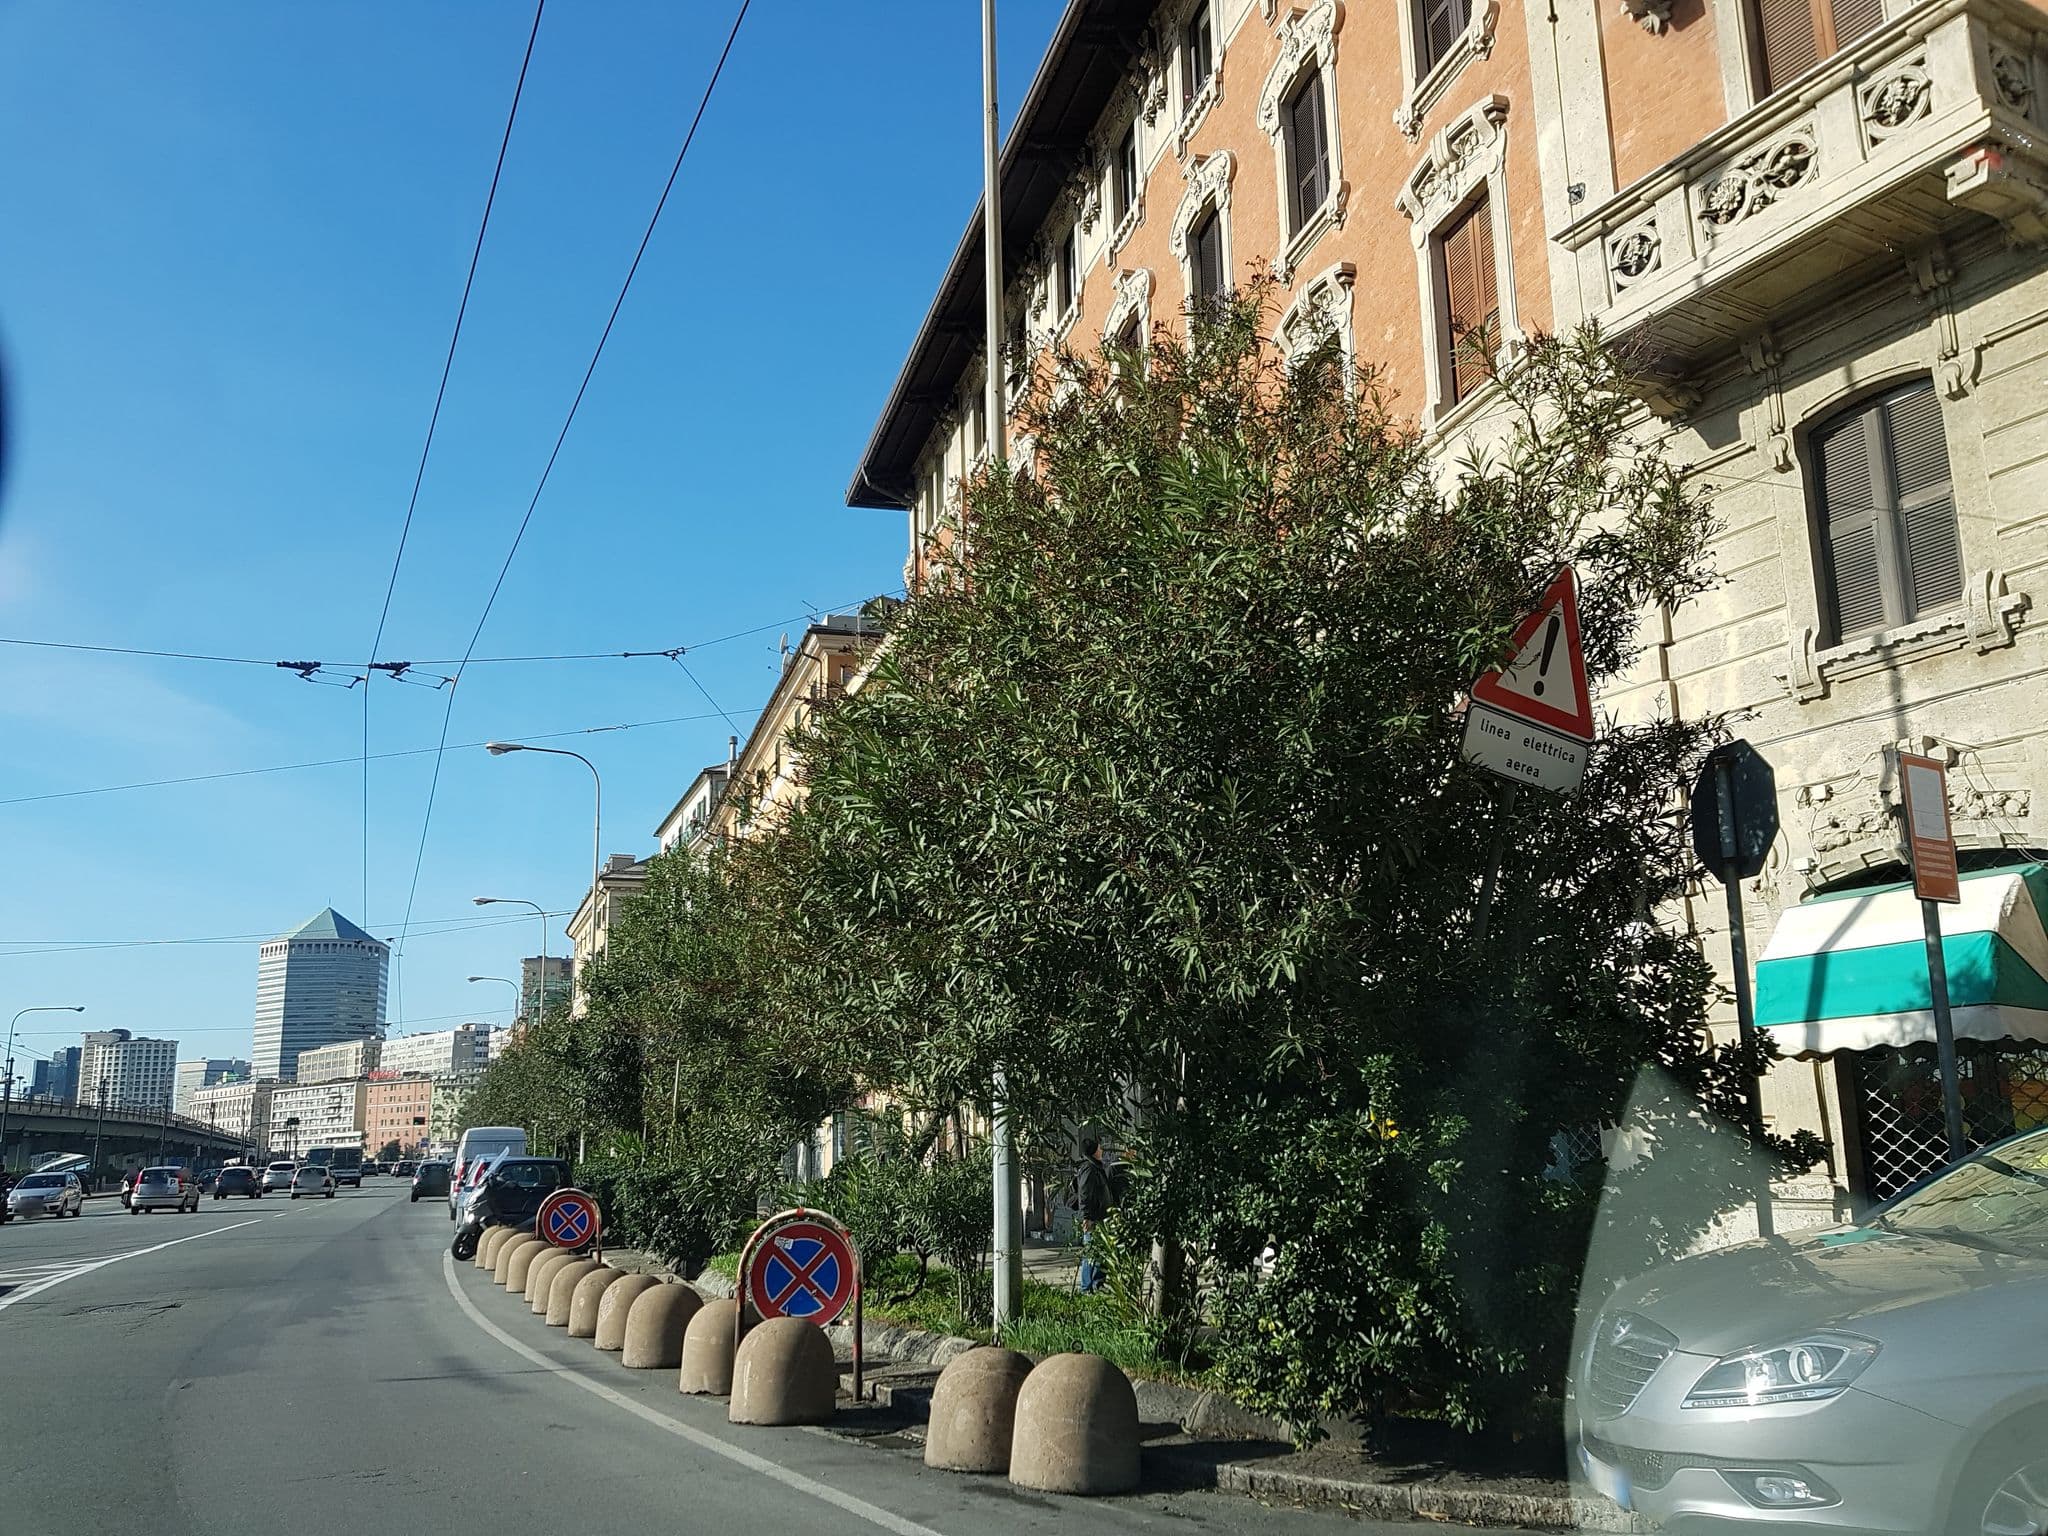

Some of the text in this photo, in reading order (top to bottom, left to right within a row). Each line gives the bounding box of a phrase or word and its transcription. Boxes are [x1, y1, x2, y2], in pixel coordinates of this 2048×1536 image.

[1480, 718, 1576, 763] linea elettrica
[1506, 758, 1540, 778] aerea
